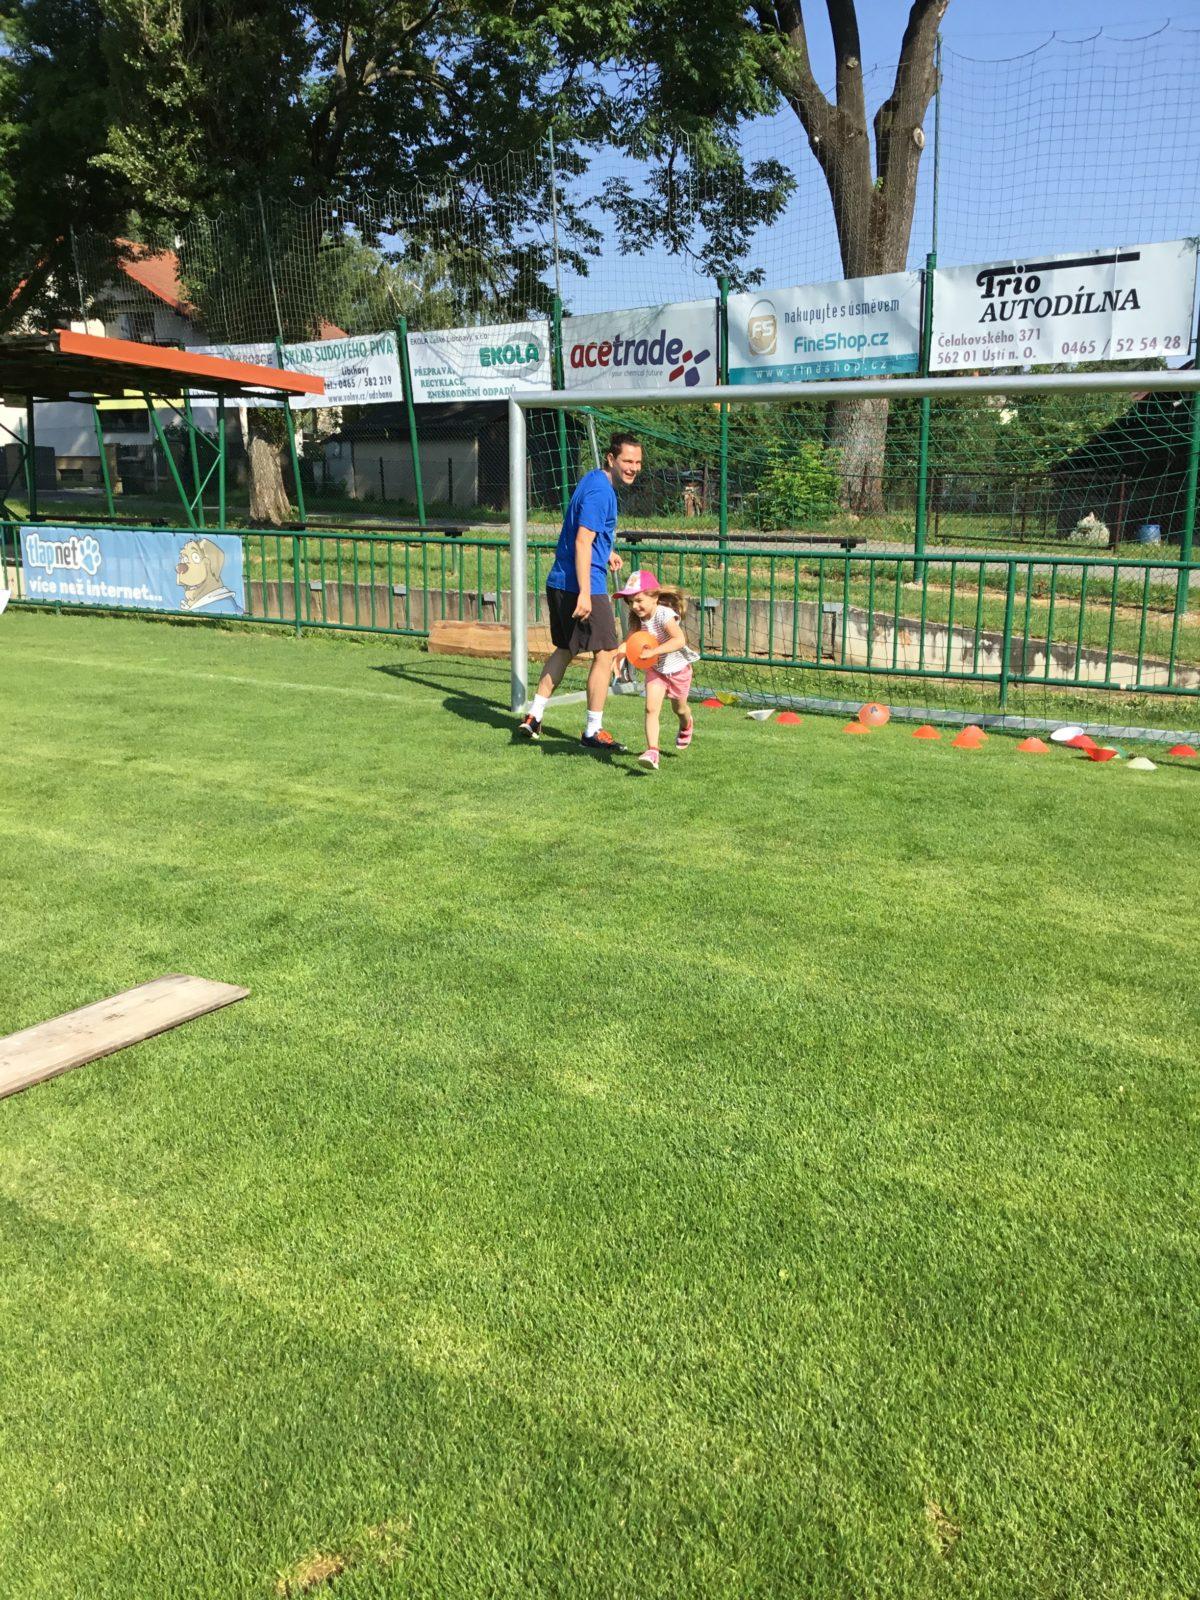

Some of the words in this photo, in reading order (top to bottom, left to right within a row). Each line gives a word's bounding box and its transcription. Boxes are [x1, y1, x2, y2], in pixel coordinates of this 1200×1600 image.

[976, 263, 1041, 298] Trio
[784, 302, 838, 325] nakupujte
[848, 299, 900, 316] úsměvem
[978, 285, 1141, 323] AUTODÍLNA
[570, 329, 683, 369] acetrade
[938, 330, 1015, 348] Čelakovského
[1019, 328, 1041, 342] 371
[1061, 341, 1096, 355] 0465
[1116, 339, 1133, 352] 52
[1139, 337, 1158, 351] 54
[1163, 335, 1182, 350] 28
[284, 348, 312, 366] SKLAD
[370, 339, 394, 356] PIVA
[479, 343, 540, 367] EKOLA
[937, 351, 959, 364] 562
[963, 350, 977, 362] 01
[982, 346, 1005, 361] Ústí
[1023, 346, 1037, 359] O.
[338, 379, 356, 389] 0465
[364, 376, 378, 387] 582
[379, 375, 392, 386] 219
[341, 365, 369, 376] Libchavy
[27, 535, 79, 572] tlapnet
[29, 576, 57, 594] více
[60, 578, 85, 596] než
[87, 581, 163, 601] internet...
